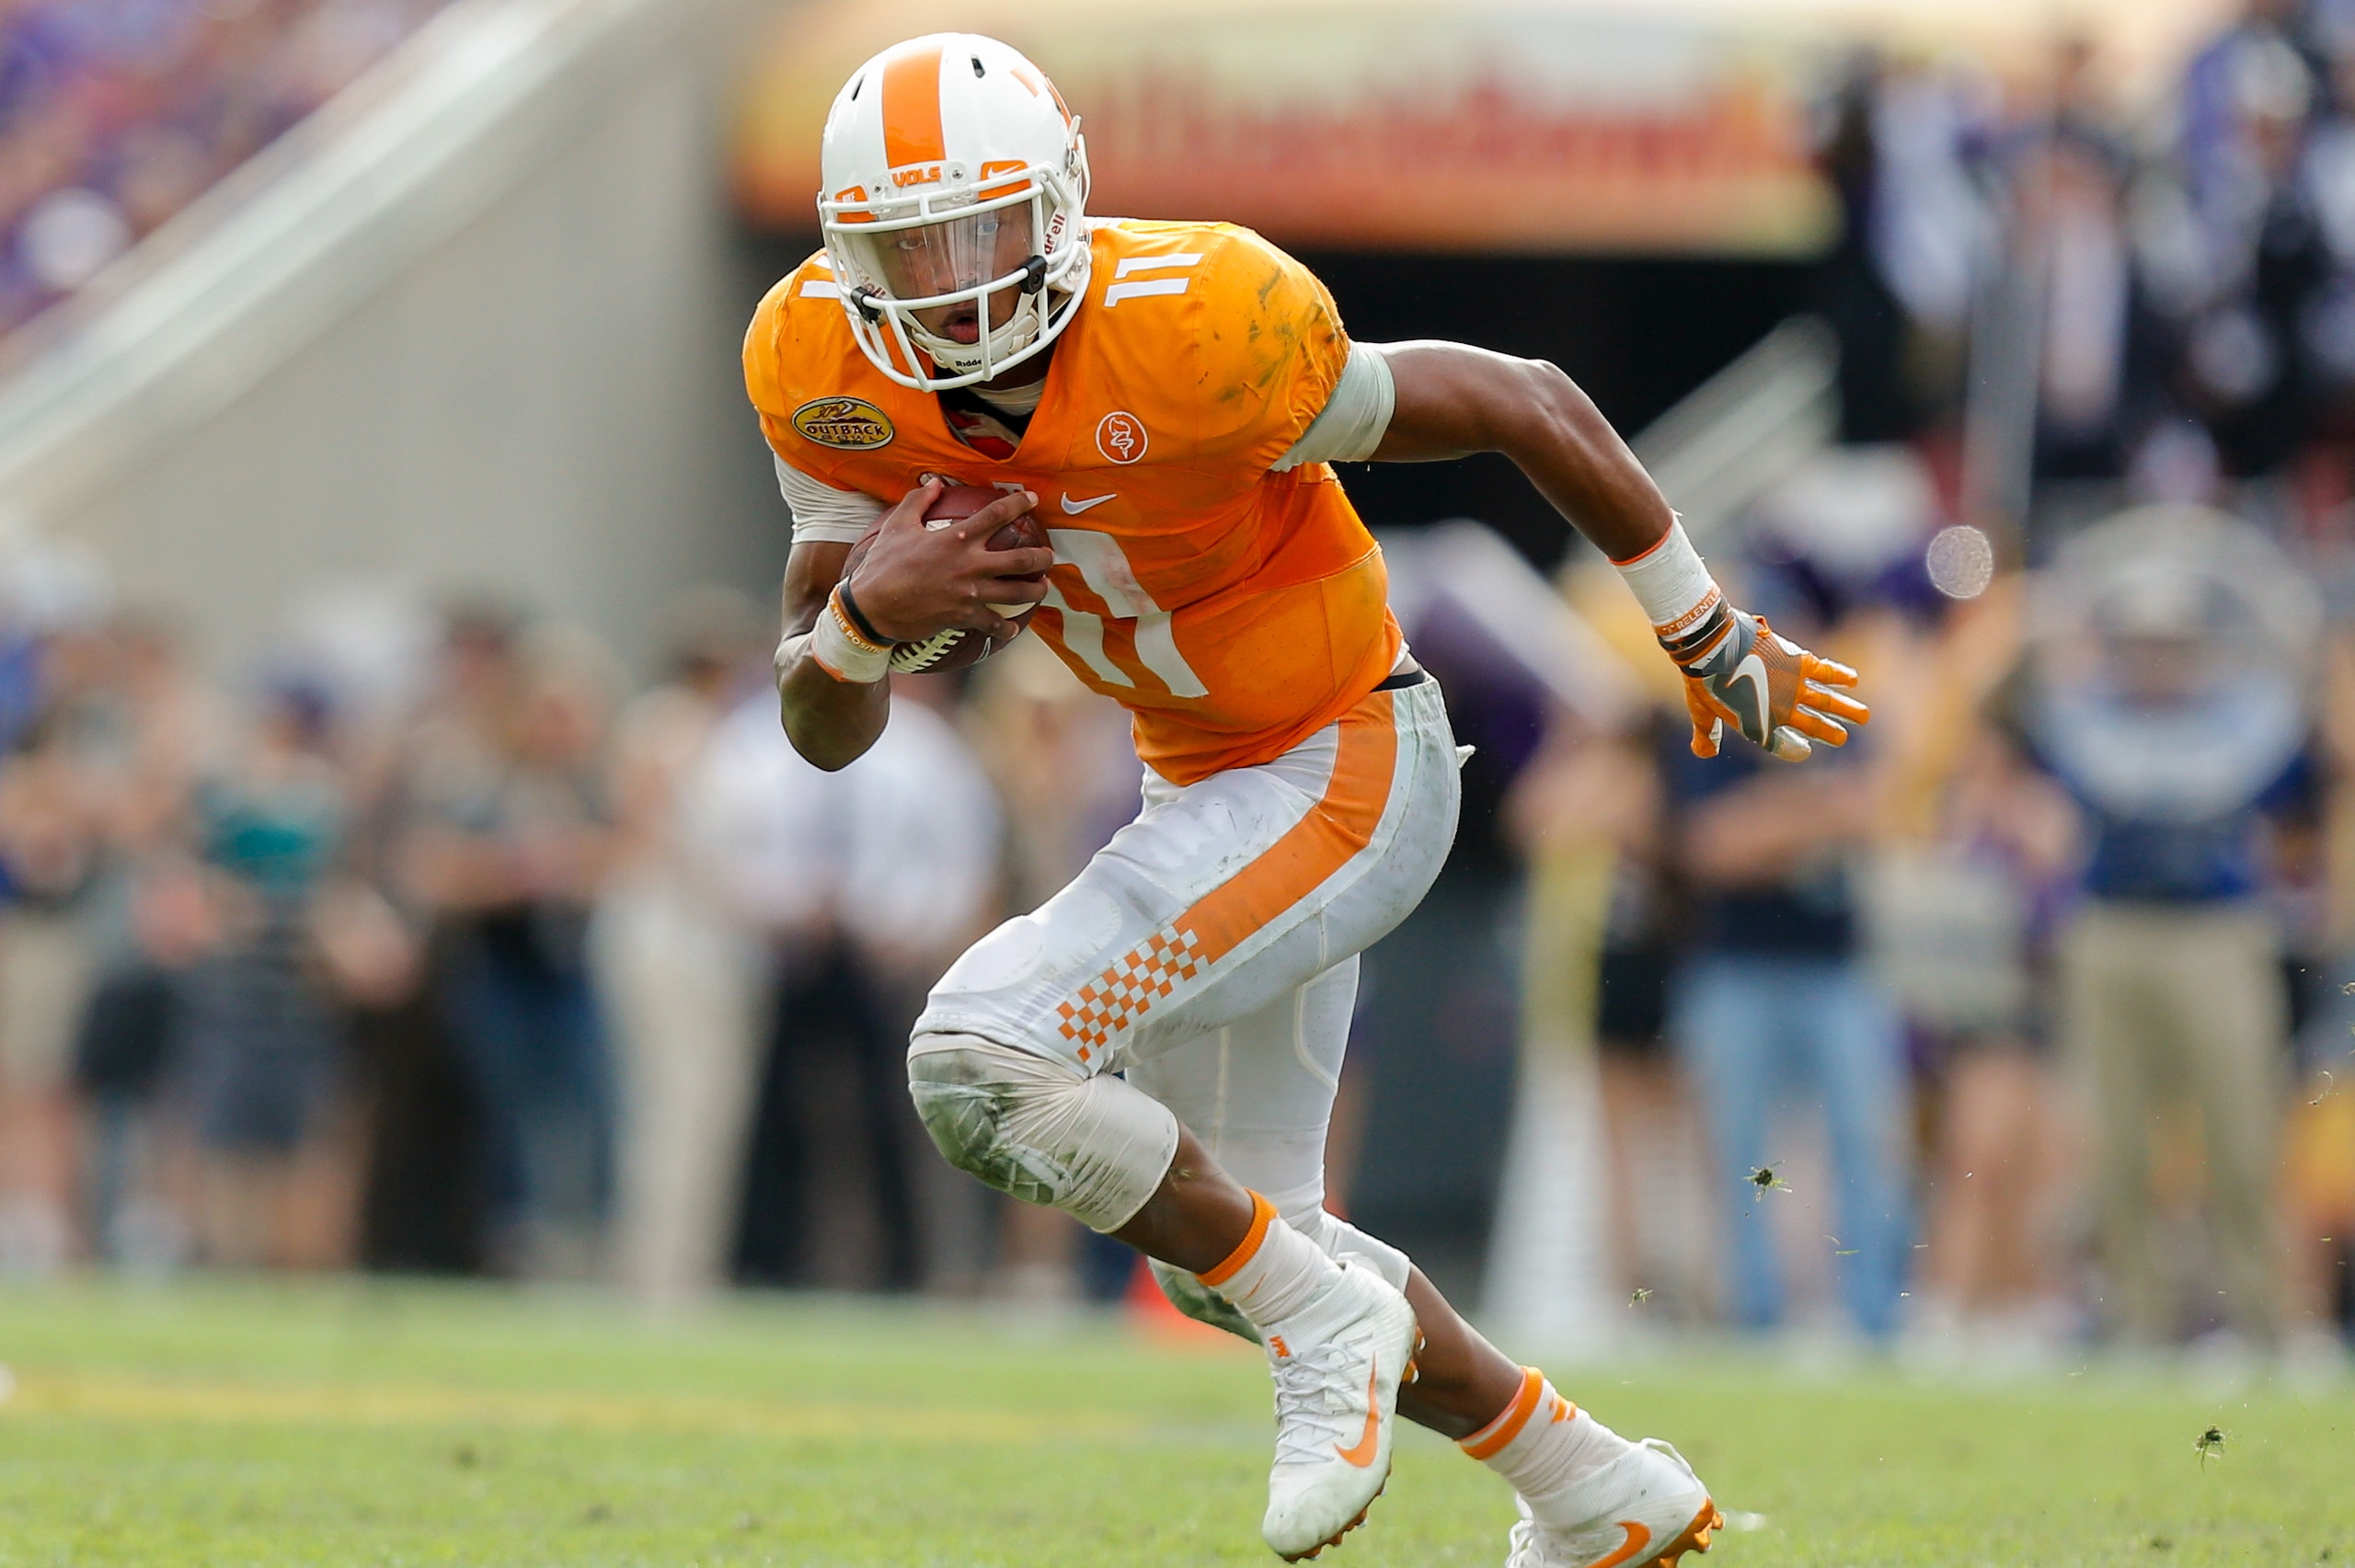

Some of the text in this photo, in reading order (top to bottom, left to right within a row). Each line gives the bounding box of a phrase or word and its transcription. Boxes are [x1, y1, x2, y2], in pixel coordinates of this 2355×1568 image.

[891, 166, 941, 188] VOLS
[805, 423, 886, 436] OUTBACK
[833, 607, 848, 631] THE
